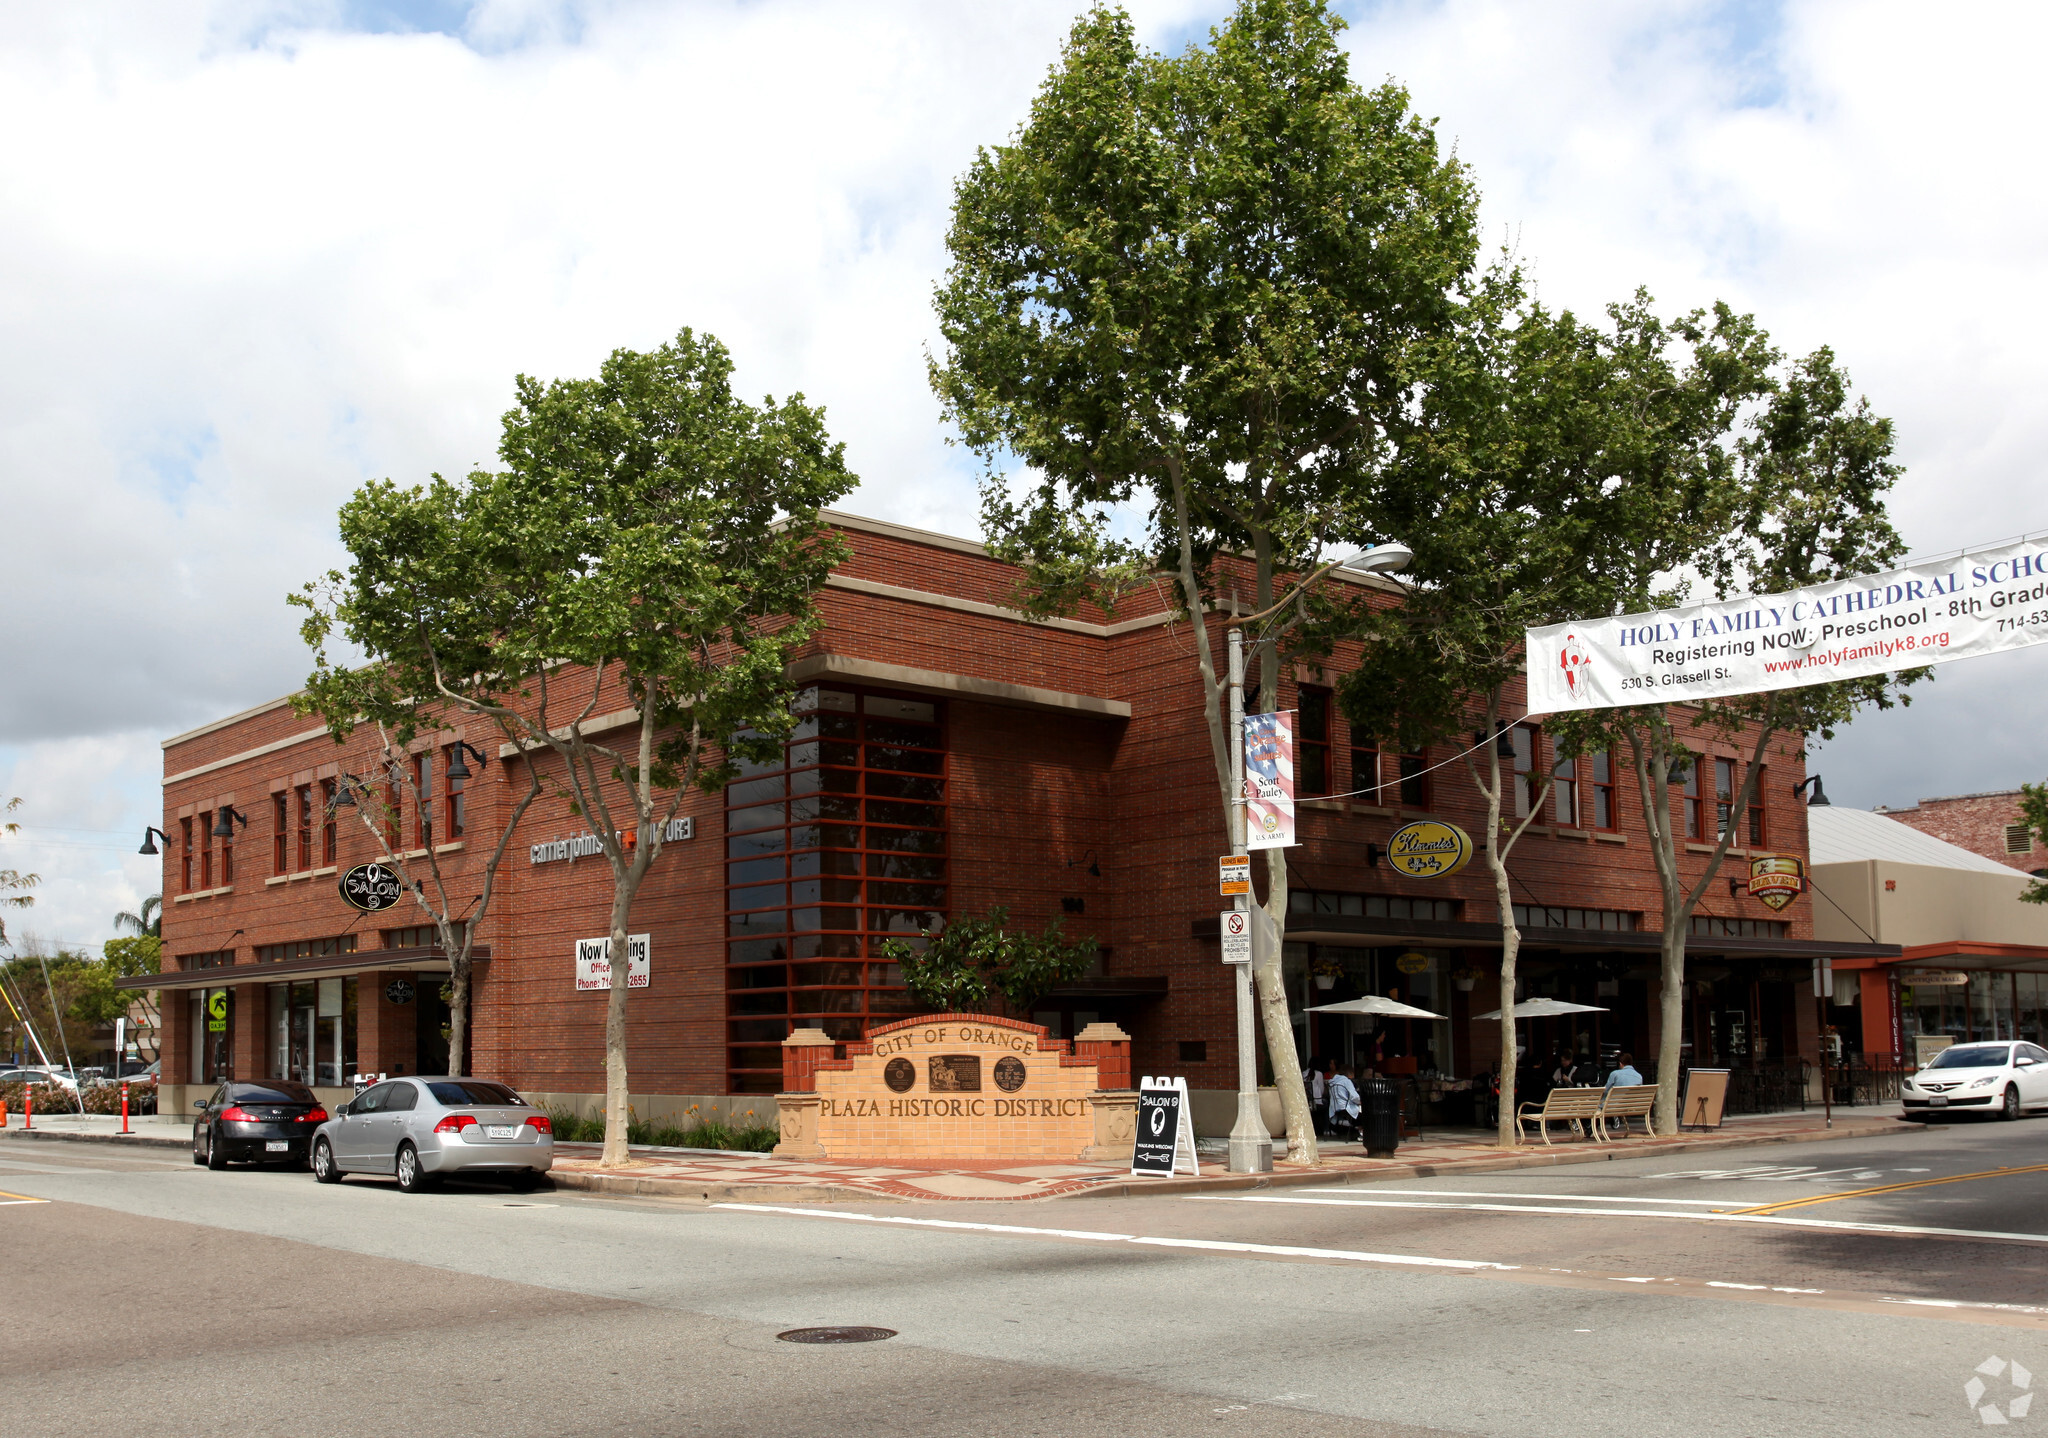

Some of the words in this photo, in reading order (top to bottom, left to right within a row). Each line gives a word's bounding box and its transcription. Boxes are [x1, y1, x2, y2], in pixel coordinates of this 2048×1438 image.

[1619, 622, 1685, 647] HOLY
[1692, 606, 1786, 639] FAMILY
[1792, 572, 1964, 622] CATHEDRAL
[1653, 640, 1755, 666] Registering
[1762, 627, 1813, 650] NOW:
[1822, 607, 1927, 640] Preschool
[1949, 597, 1982, 617] 8th
[1990, 582, 2048, 608] Grad
[1621, 677, 1642, 690] 530
[1645, 676, 1658, 688] S.
[1661, 669, 1711, 686] Glassell
[1714, 667, 1732, 680] St.
[1765, 631, 1949, 673] www.holyfamilyk8.org
[1250, 734, 1286, 747] Orange
[1254, 751, 1282, 762] salutes
[1258, 776, 1280, 787] Scott
[1256, 787, 1283, 799] Pauley
[1267, 832, 1286, 840] ARMY
[347, 879, 400, 896] SALON
[1751, 875, 1799, 890] HAVEN
[367, 895, 380, 909] 9
[579, 941, 602, 961] Now
[604, 937, 646, 962] Ling
[590, 962, 611, 974] Office
[577, 978, 600, 989] Phone:
[876, 1034, 914, 1058] CITY
[924, 1028, 946, 1043] OF
[959, 1027, 1034, 1056] ORANGE
[820, 1099, 882, 1117] PLAZA
[889, 1099, 985, 1117] HISTORIC
[994, 1099, 1088, 1117] DISTRICT
[1141, 1096, 1170, 1107] SALON
[1171, 1097, 1179, 1107] 9
